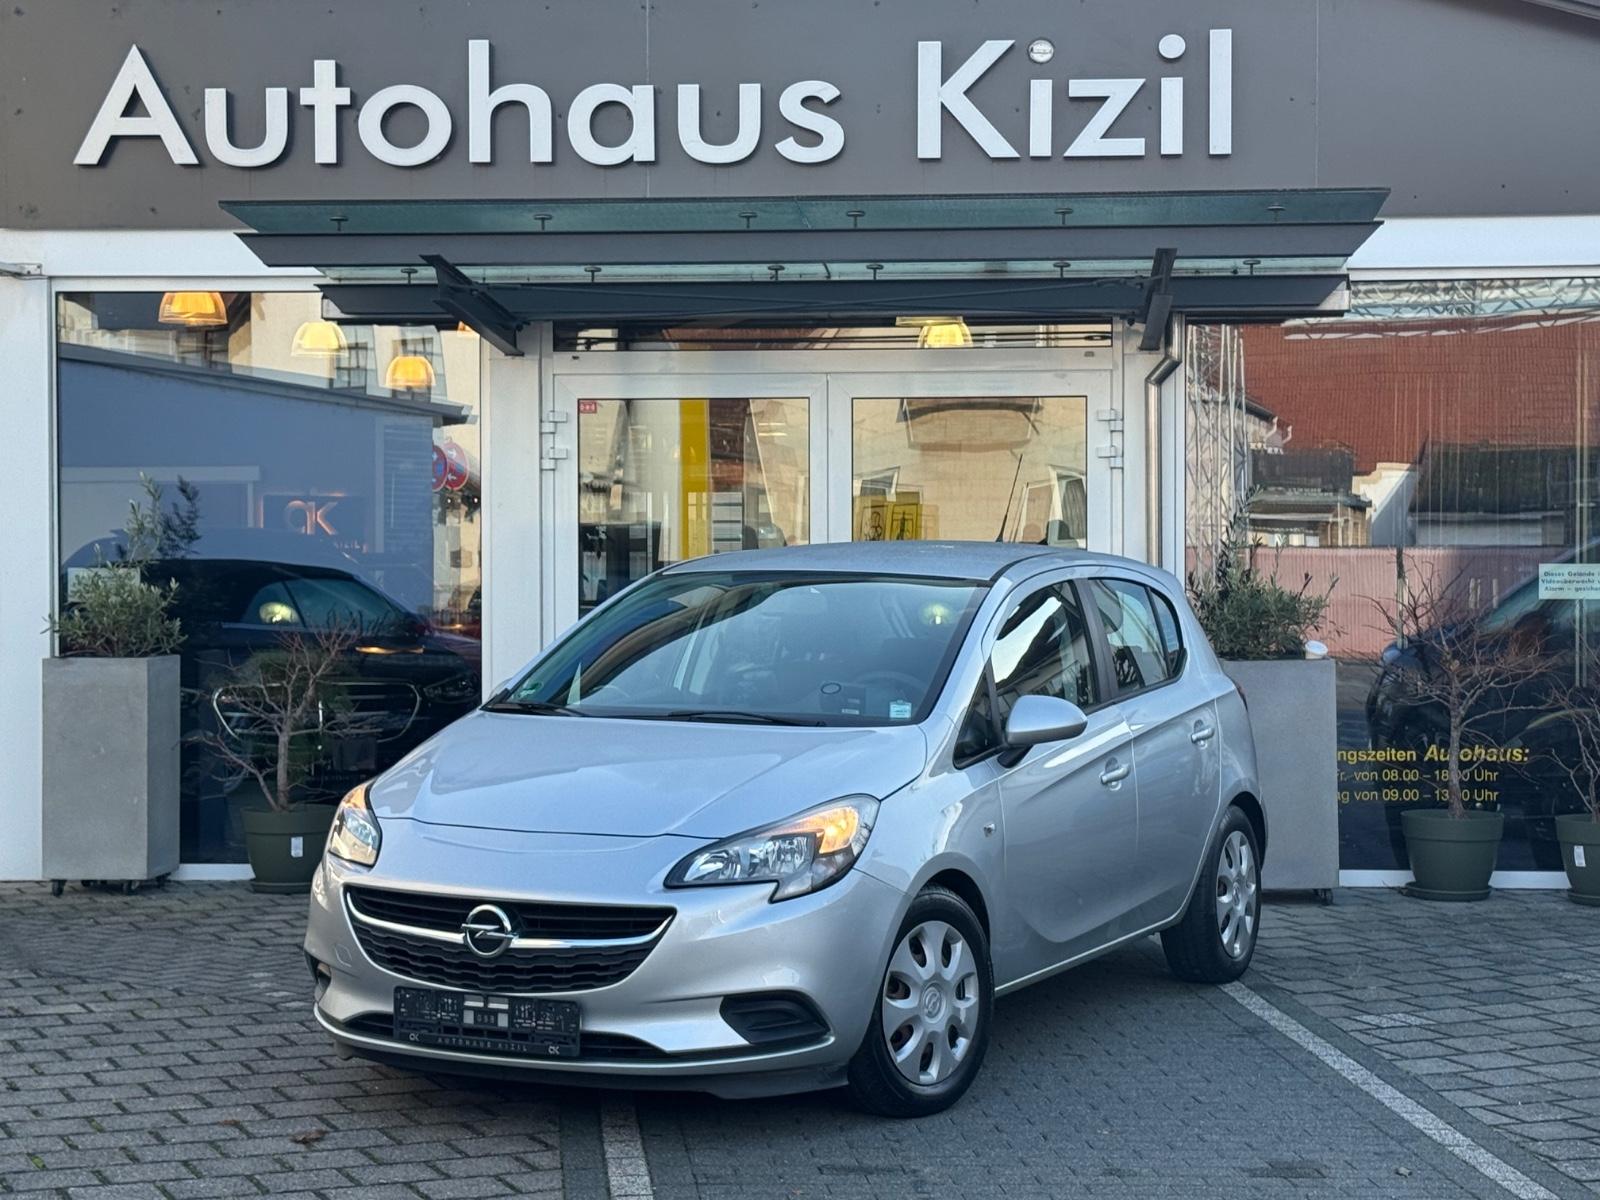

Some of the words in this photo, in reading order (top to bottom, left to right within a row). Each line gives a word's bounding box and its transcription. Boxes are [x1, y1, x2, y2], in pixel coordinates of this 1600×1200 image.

[73, 39, 845, 167] Autohaus
[917, 28, 1233, 159] Kizil
[1337, 747, 1416, 764] ngszeiten
[1424, 744, 1530, 762] Auohaus:
[1353, 771, 1378, 781] von
[1382, 769, 1420, 781] 08.00
[1434, 769, 1471, 782] 180
[1474, 769, 1499, 782] Uhr
[1353, 791, 1378, 801] von
[1382, 789, 1420, 801] 09.00
[1434, 789, 1471, 801] 130
[1474, 789, 1499, 801] Uhr
[437, 1037, 491, 1048] AUTOHAUS
